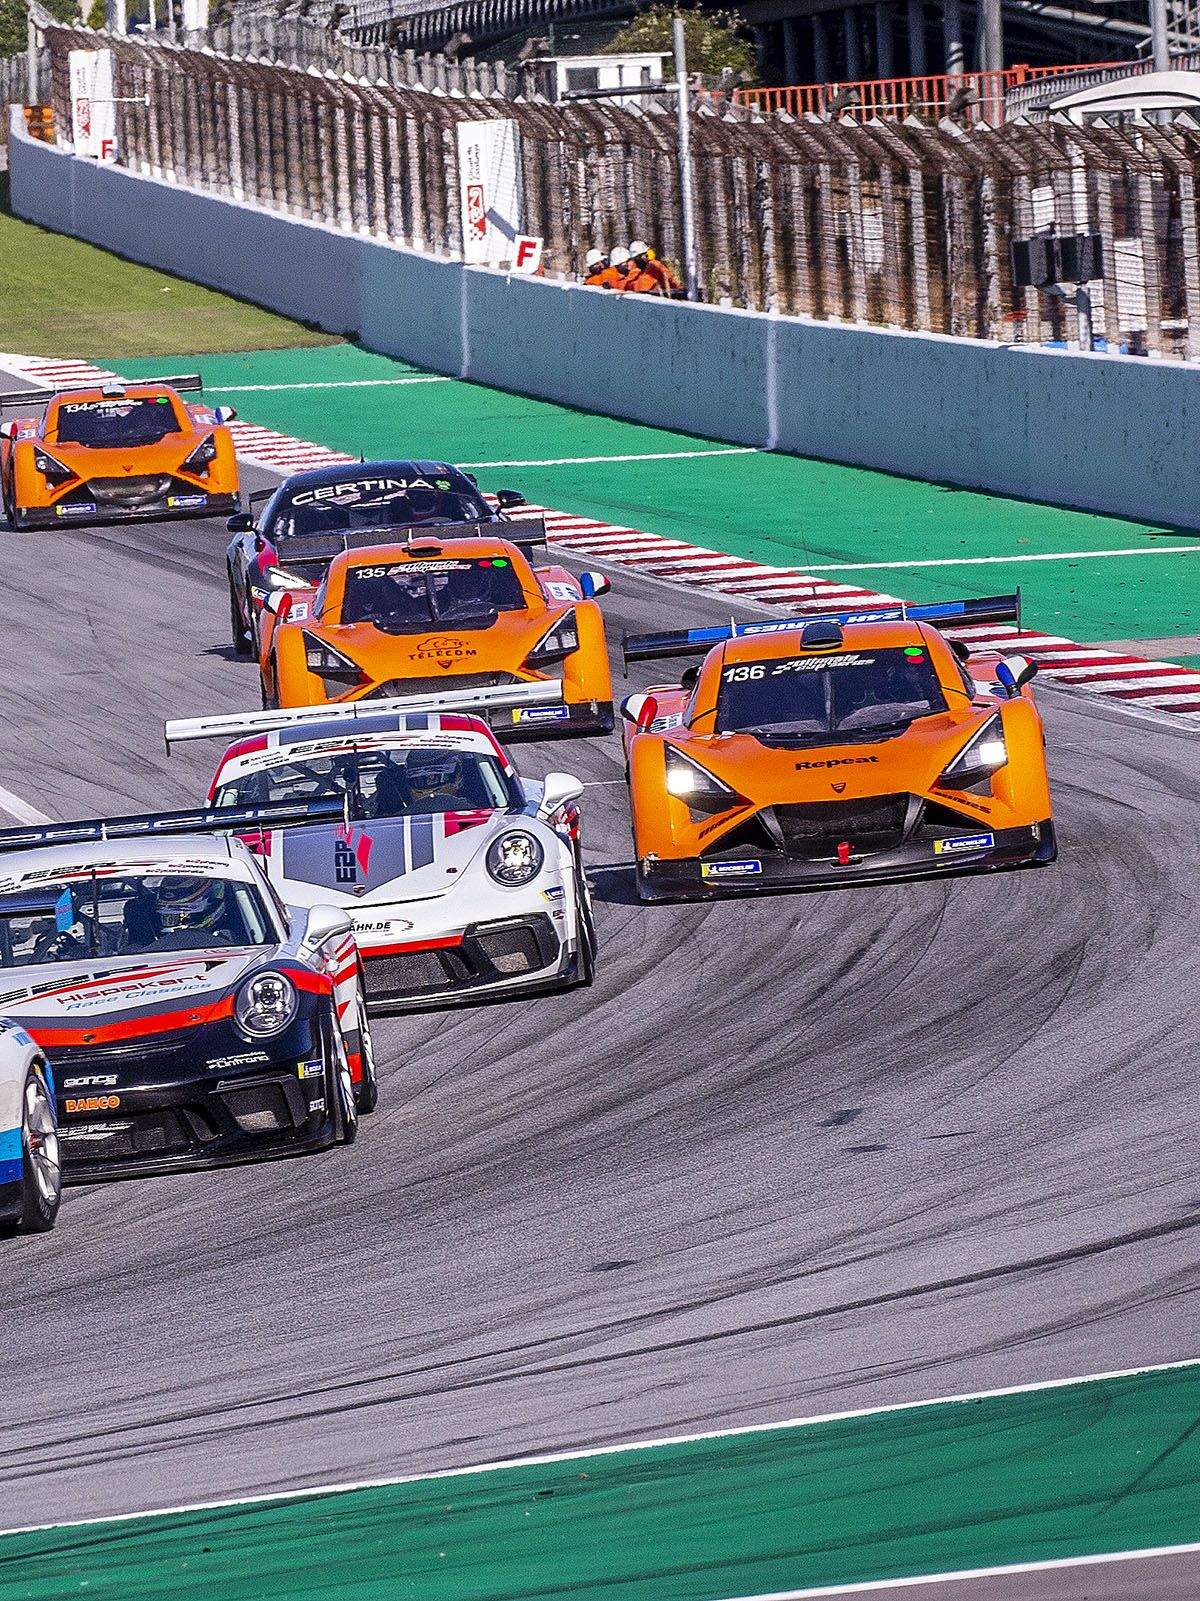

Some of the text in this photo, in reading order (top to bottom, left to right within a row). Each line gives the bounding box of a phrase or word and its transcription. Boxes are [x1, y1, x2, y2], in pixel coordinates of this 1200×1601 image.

[101, 139, 113, 159] F
[516, 240, 537, 267] F
[291, 479, 435, 506] CERTINA
[355, 567, 386, 579] 135
[723, 665, 766, 683] 136
[794, 755, 880, 771] Repeat
[65, 982, 212, 1011] Race Classics
